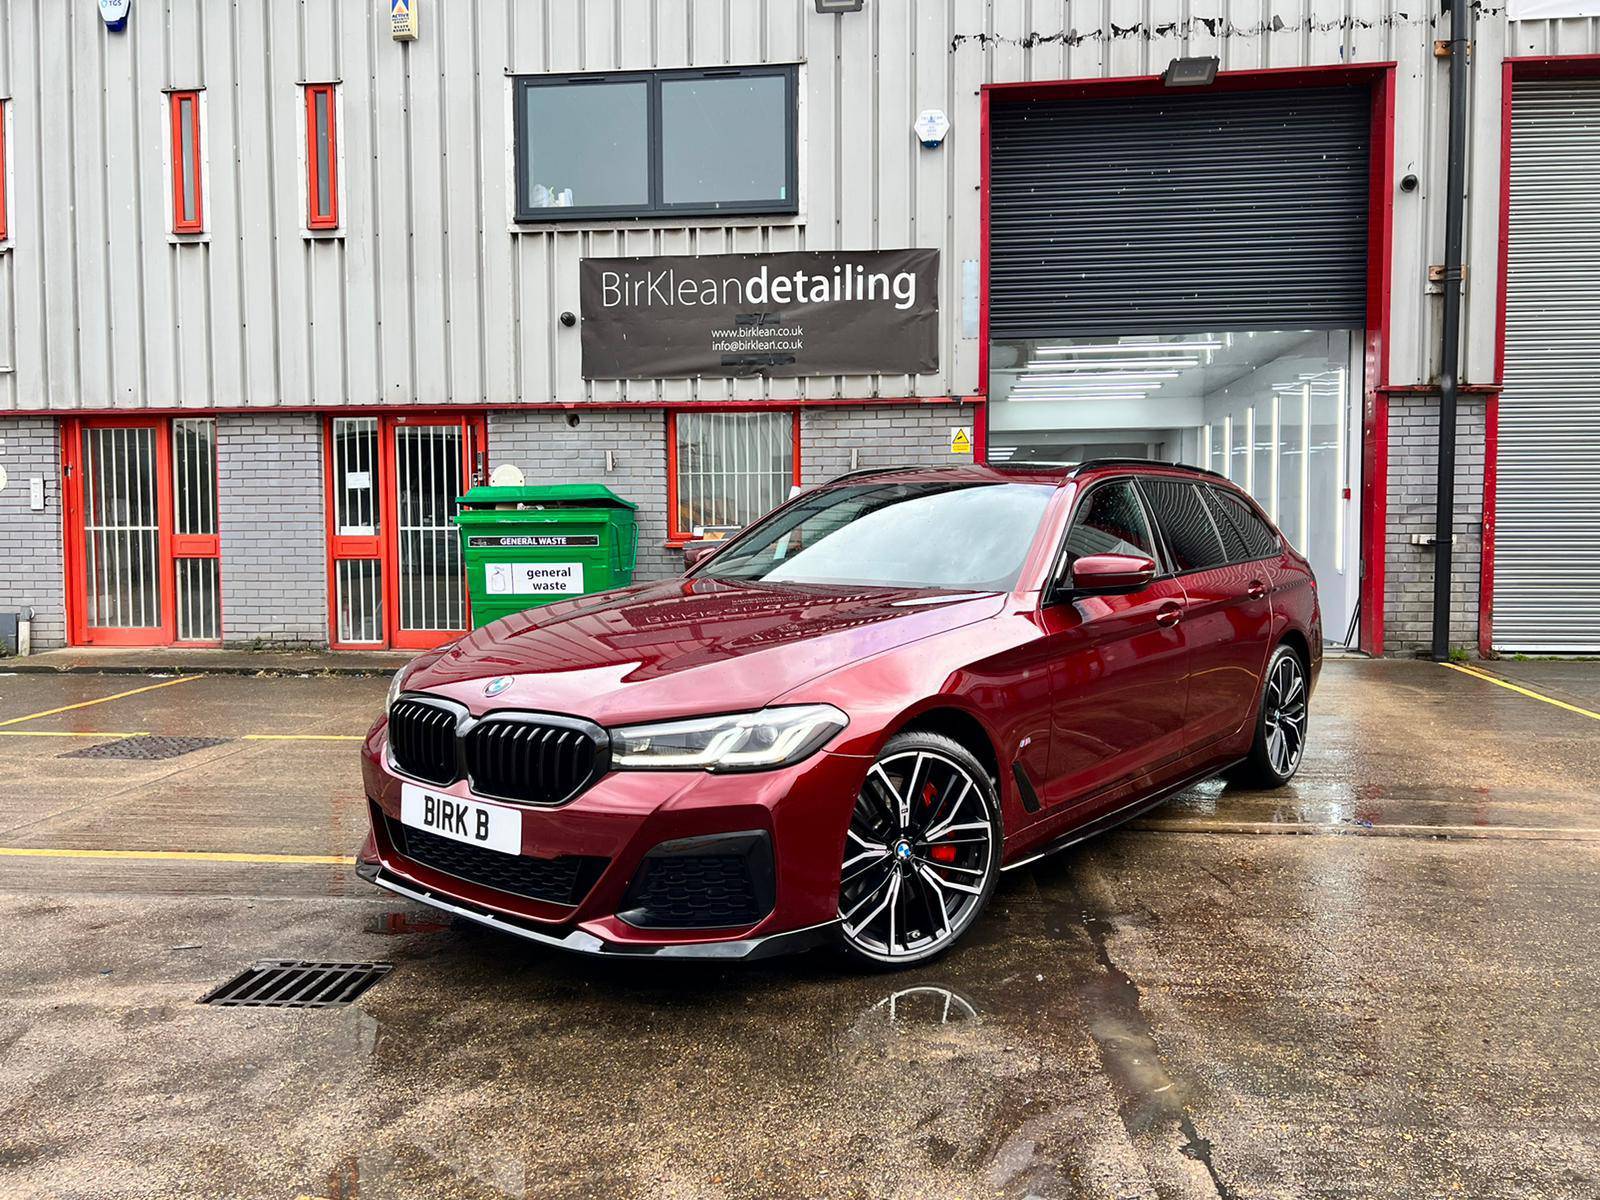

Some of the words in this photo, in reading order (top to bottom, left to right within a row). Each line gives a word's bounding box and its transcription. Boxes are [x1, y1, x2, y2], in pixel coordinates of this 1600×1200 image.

[602, 264, 917, 309] BirKleandetailing
[711, 325, 804, 338] www.birklean.co.uk
[712, 339, 803, 352] info@birklean.co.uk
[500, 537, 538, 546] GENERAL
[538, 537, 567, 545] WASTE
[526, 567, 571, 579] general
[532, 581, 567, 590] waste
[424, 795, 469, 837] BIRK
[475, 808, 489, 841] B
